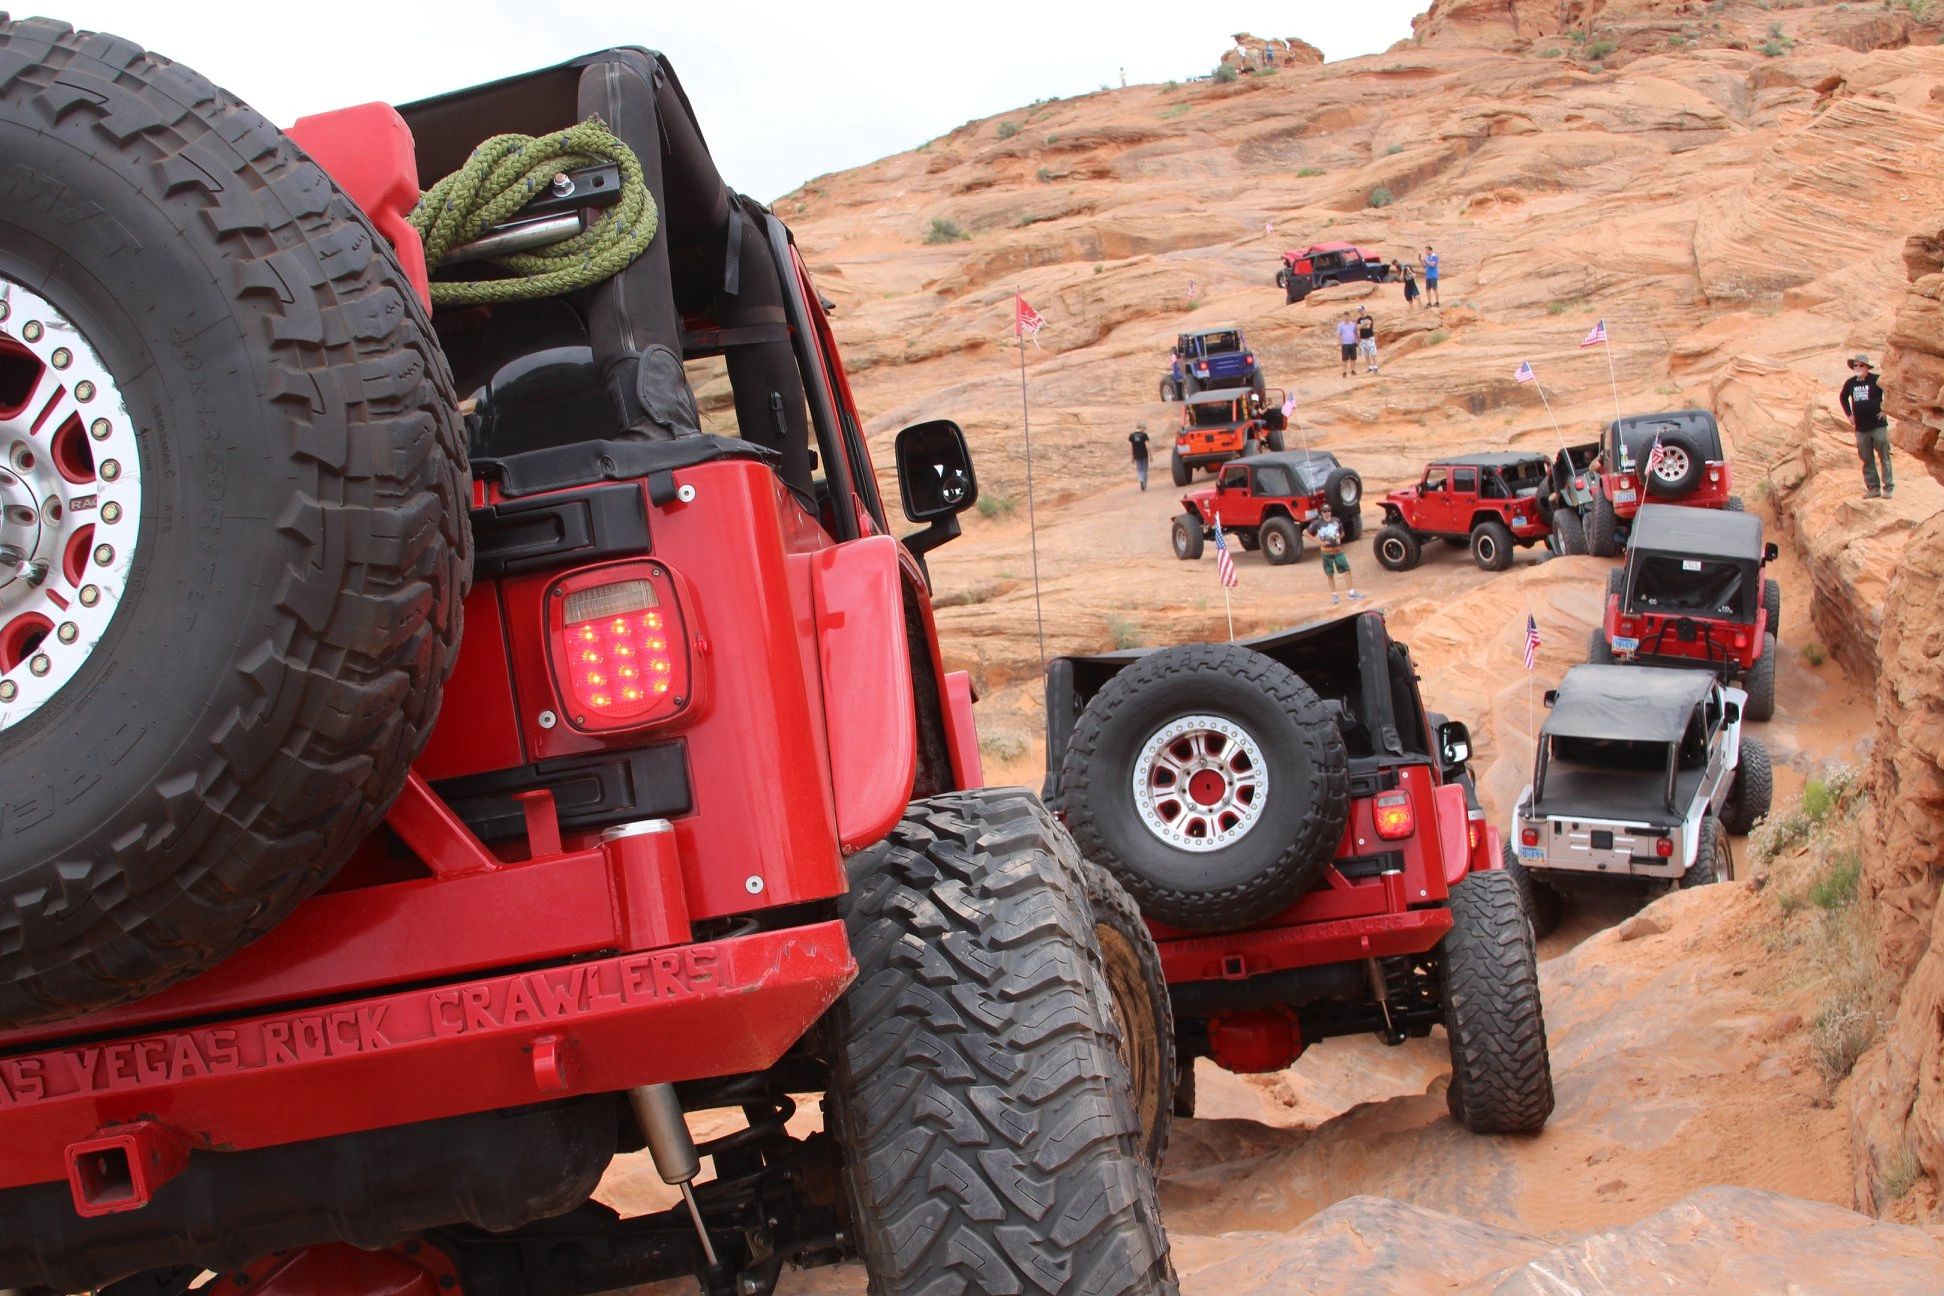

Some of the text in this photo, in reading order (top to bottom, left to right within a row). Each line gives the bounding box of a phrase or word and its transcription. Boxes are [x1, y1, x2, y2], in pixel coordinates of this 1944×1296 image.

[63, 1029, 240, 1093] VEGAS
[262, 1005, 391, 1066] ROCK
[430, 946, 720, 1037] CRAWLERS
